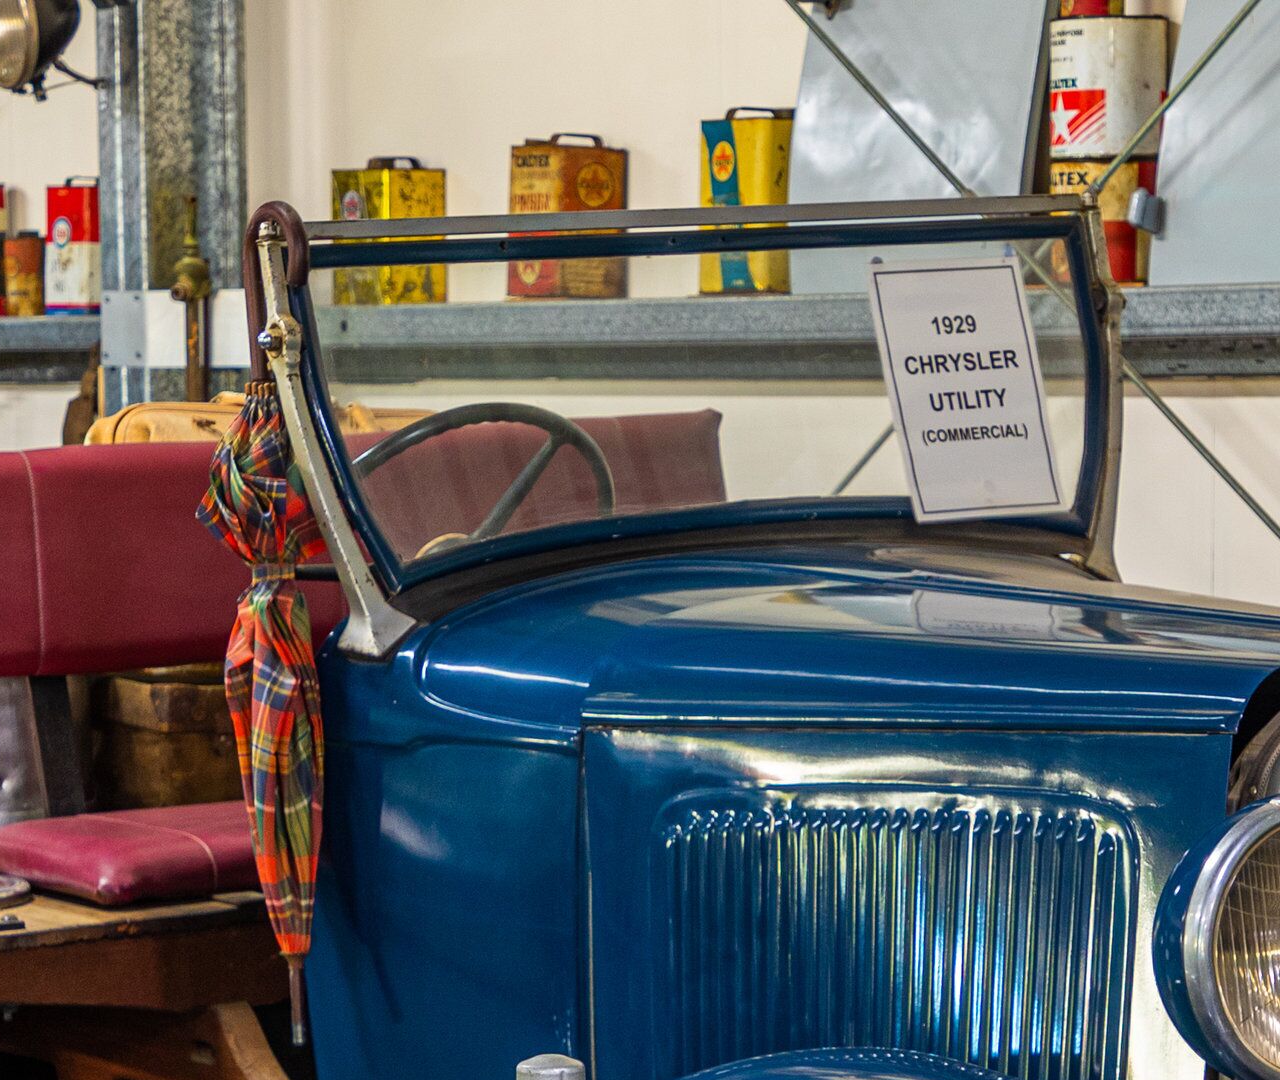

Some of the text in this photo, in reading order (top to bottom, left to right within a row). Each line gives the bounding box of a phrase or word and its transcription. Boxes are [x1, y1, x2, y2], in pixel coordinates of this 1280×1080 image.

[930, 314, 977, 336] 1929
[904, 349, 1019, 377] CHRYSLER
[929, 387, 1007, 413] UTILITY
[922, 423, 1029, 446] (COMMERCIAL)
